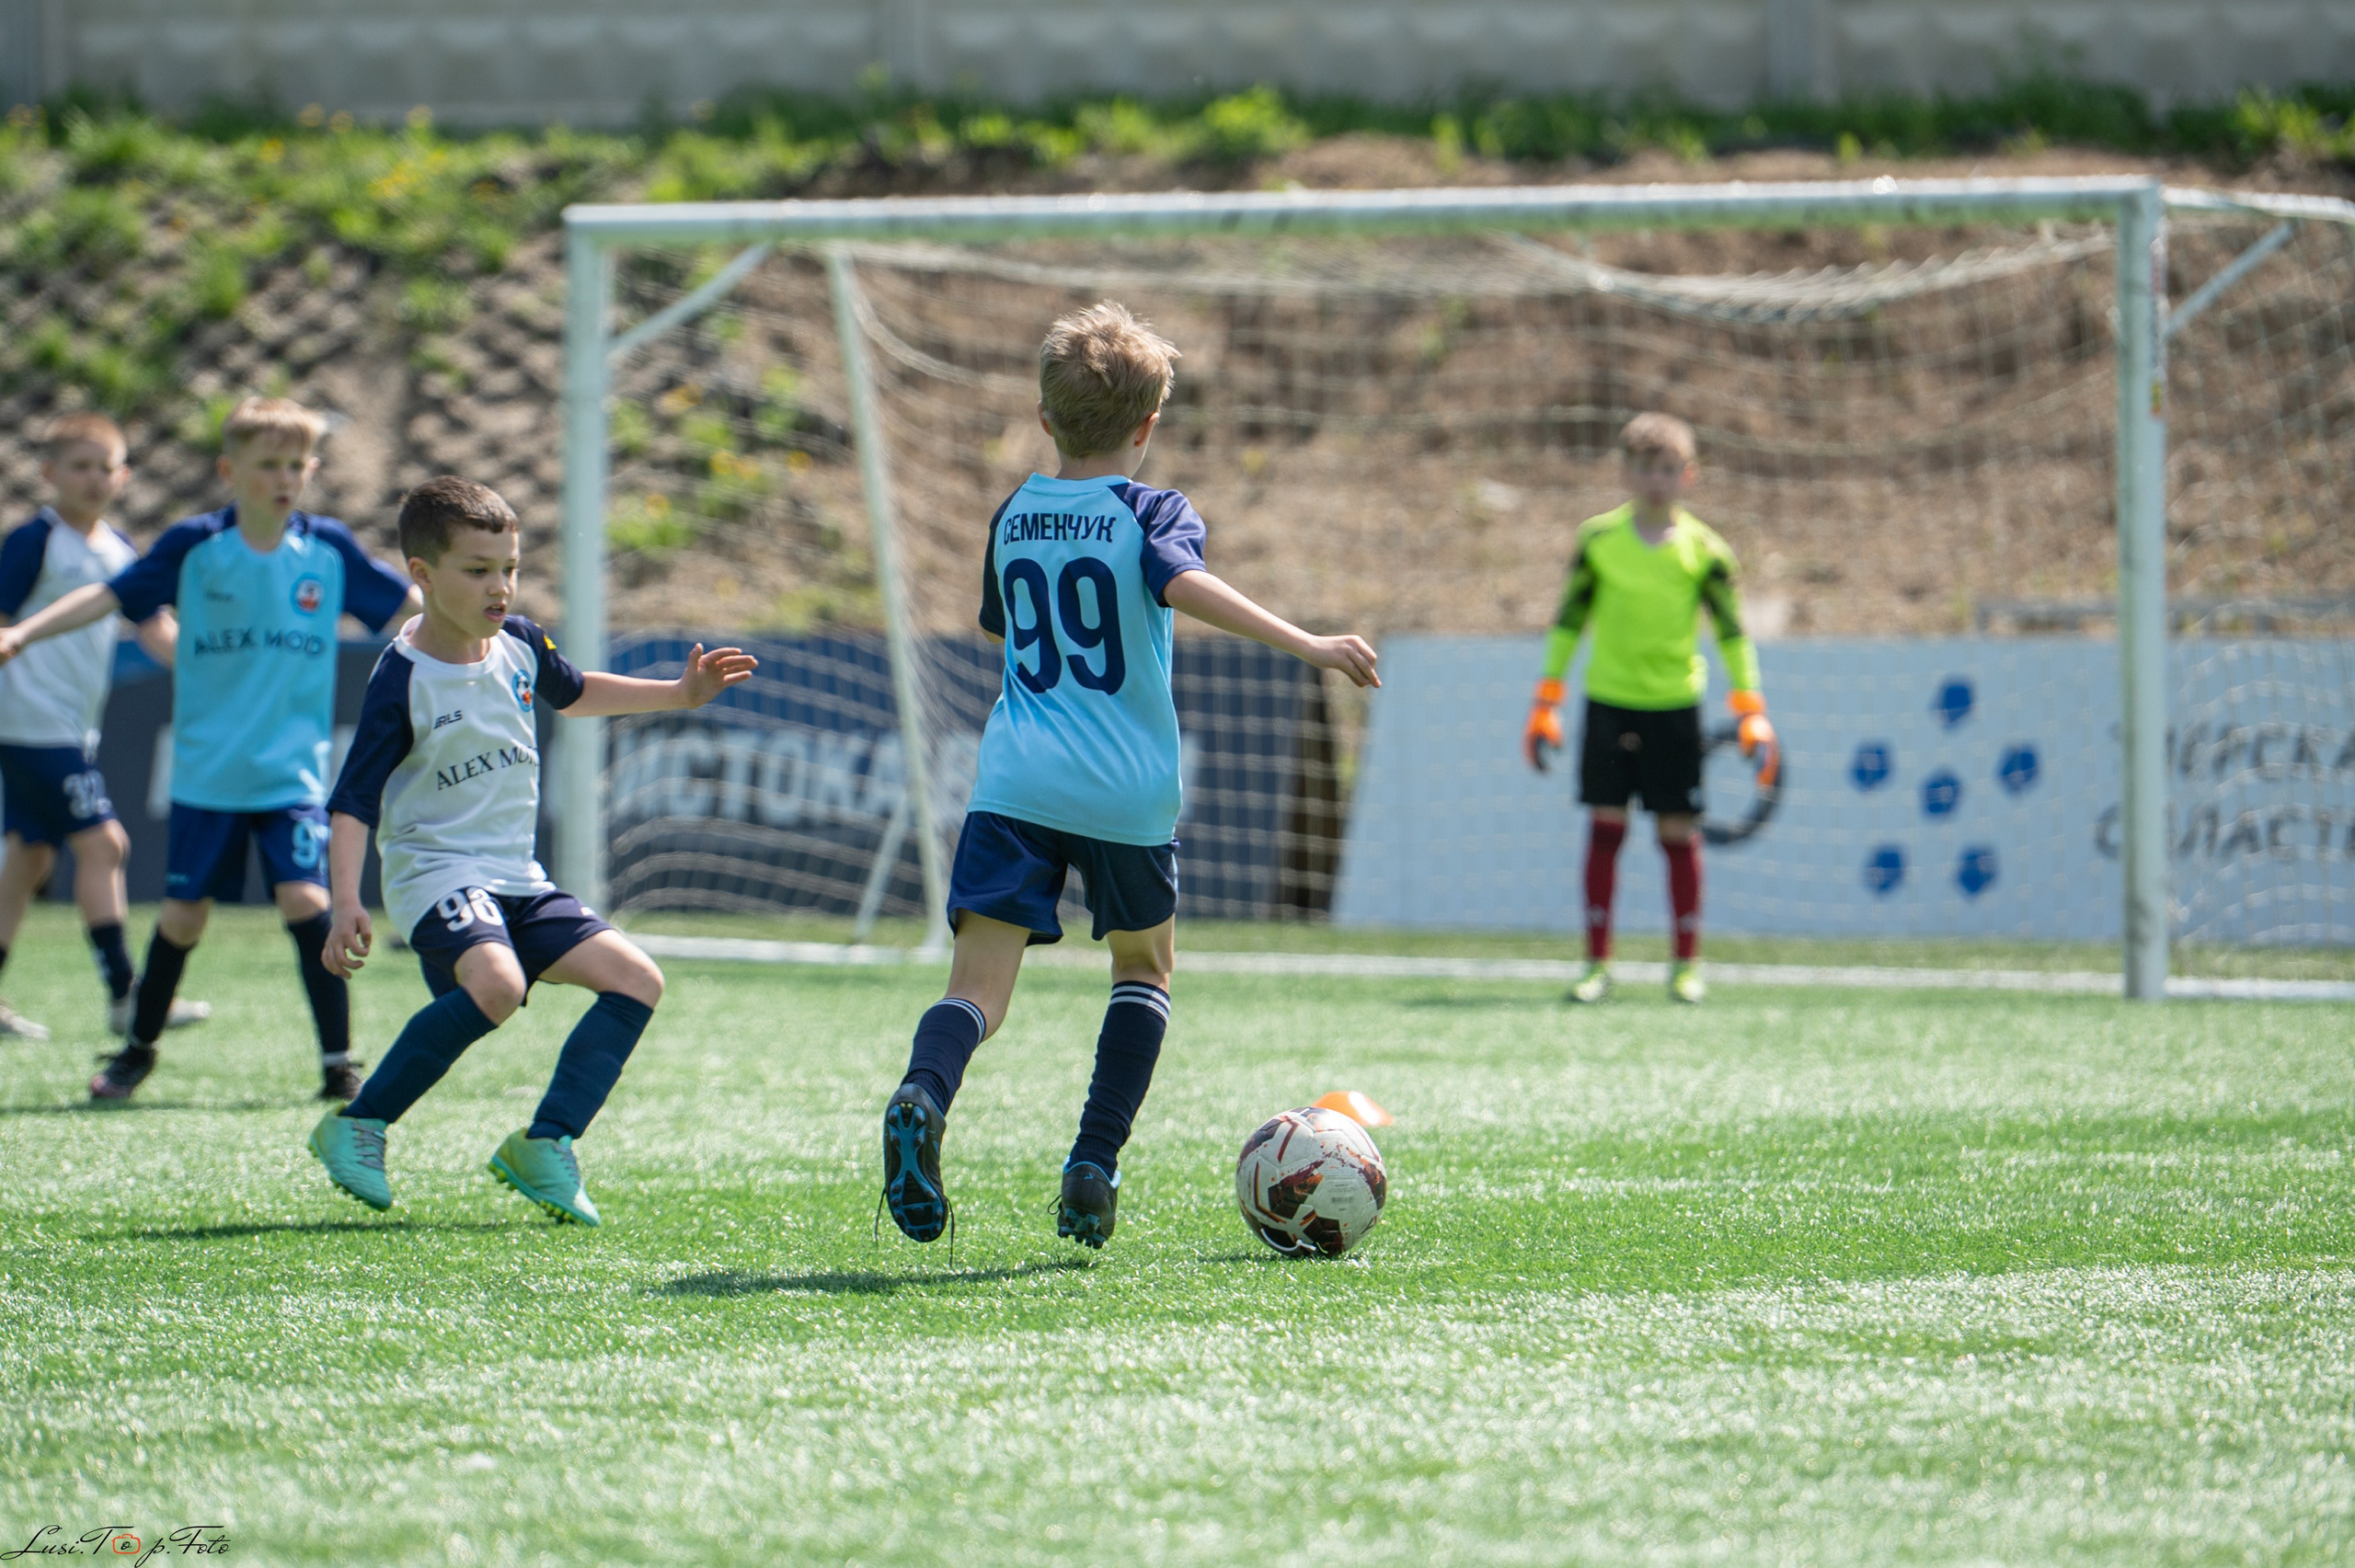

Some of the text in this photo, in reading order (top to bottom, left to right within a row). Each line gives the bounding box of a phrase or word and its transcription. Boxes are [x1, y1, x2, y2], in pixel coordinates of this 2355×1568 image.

[1004, 512, 1117, 545] СЕМЕНЧУК
[195, 627, 253, 658] ALEX
[1004, 556, 1126, 696] 99
[436, 751, 495, 791] ALEX
